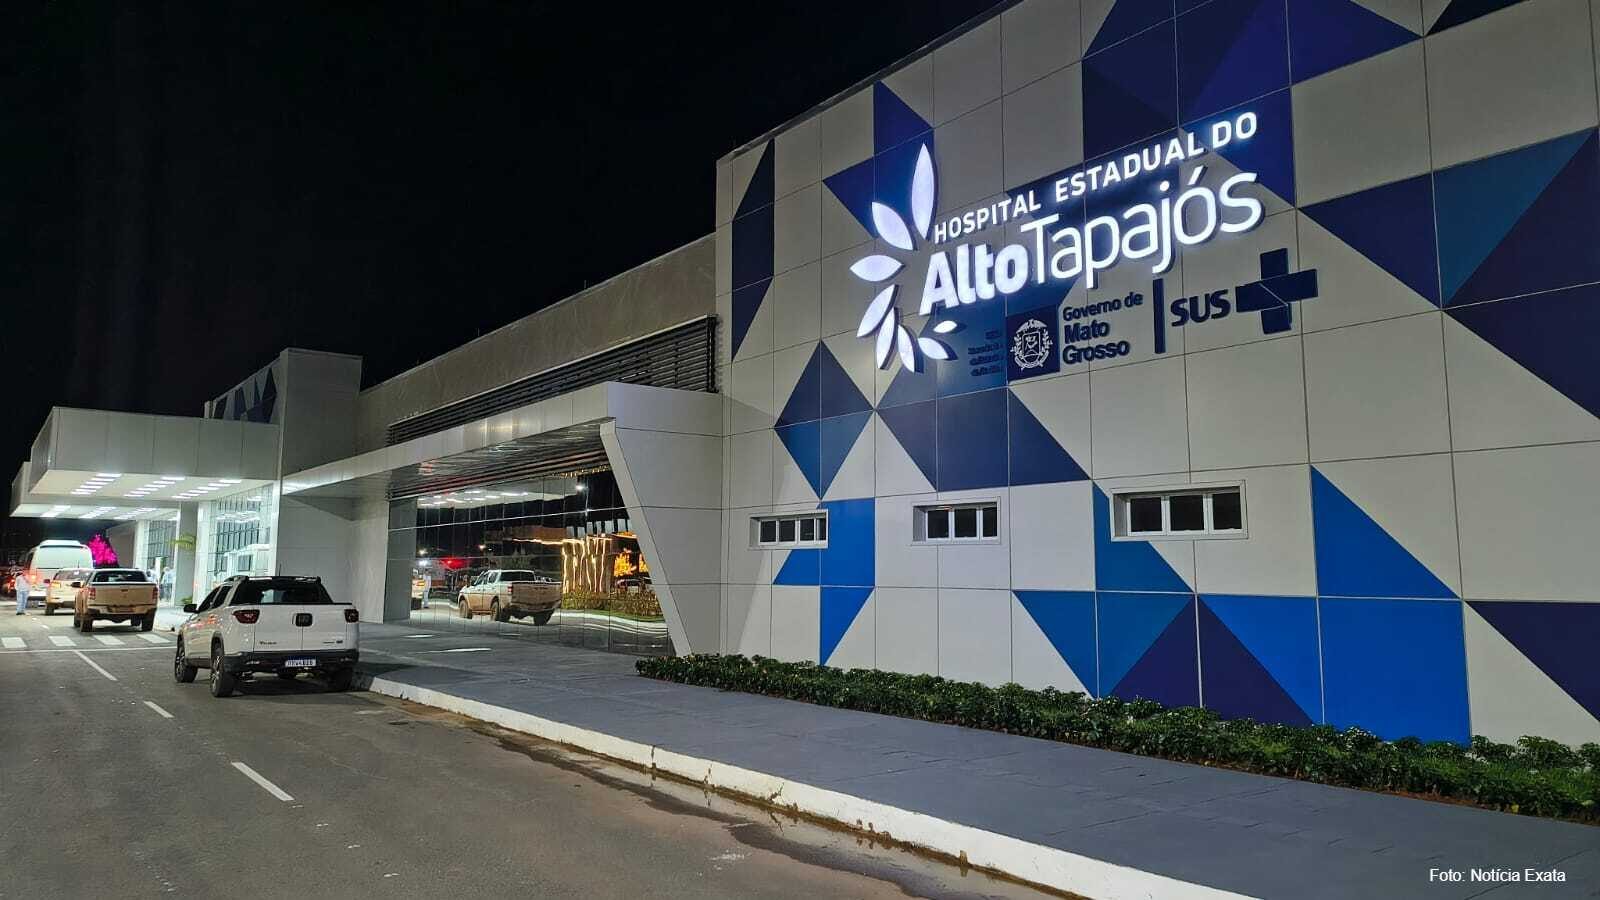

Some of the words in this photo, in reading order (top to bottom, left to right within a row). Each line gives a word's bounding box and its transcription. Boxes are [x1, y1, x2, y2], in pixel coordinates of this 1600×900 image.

[933, 190, 1042, 244] HOSPITAL
[1055, 131, 1204, 202] ESTADUAL
[1211, 111, 1257, 149] DO
[1062, 298, 1122, 322] Governo
[1123, 291, 1144, 308] de
[1170, 288, 1232, 327] SUS
[1064, 319, 1111, 344] Mato
[1062, 340, 1131, 365] Grosso
